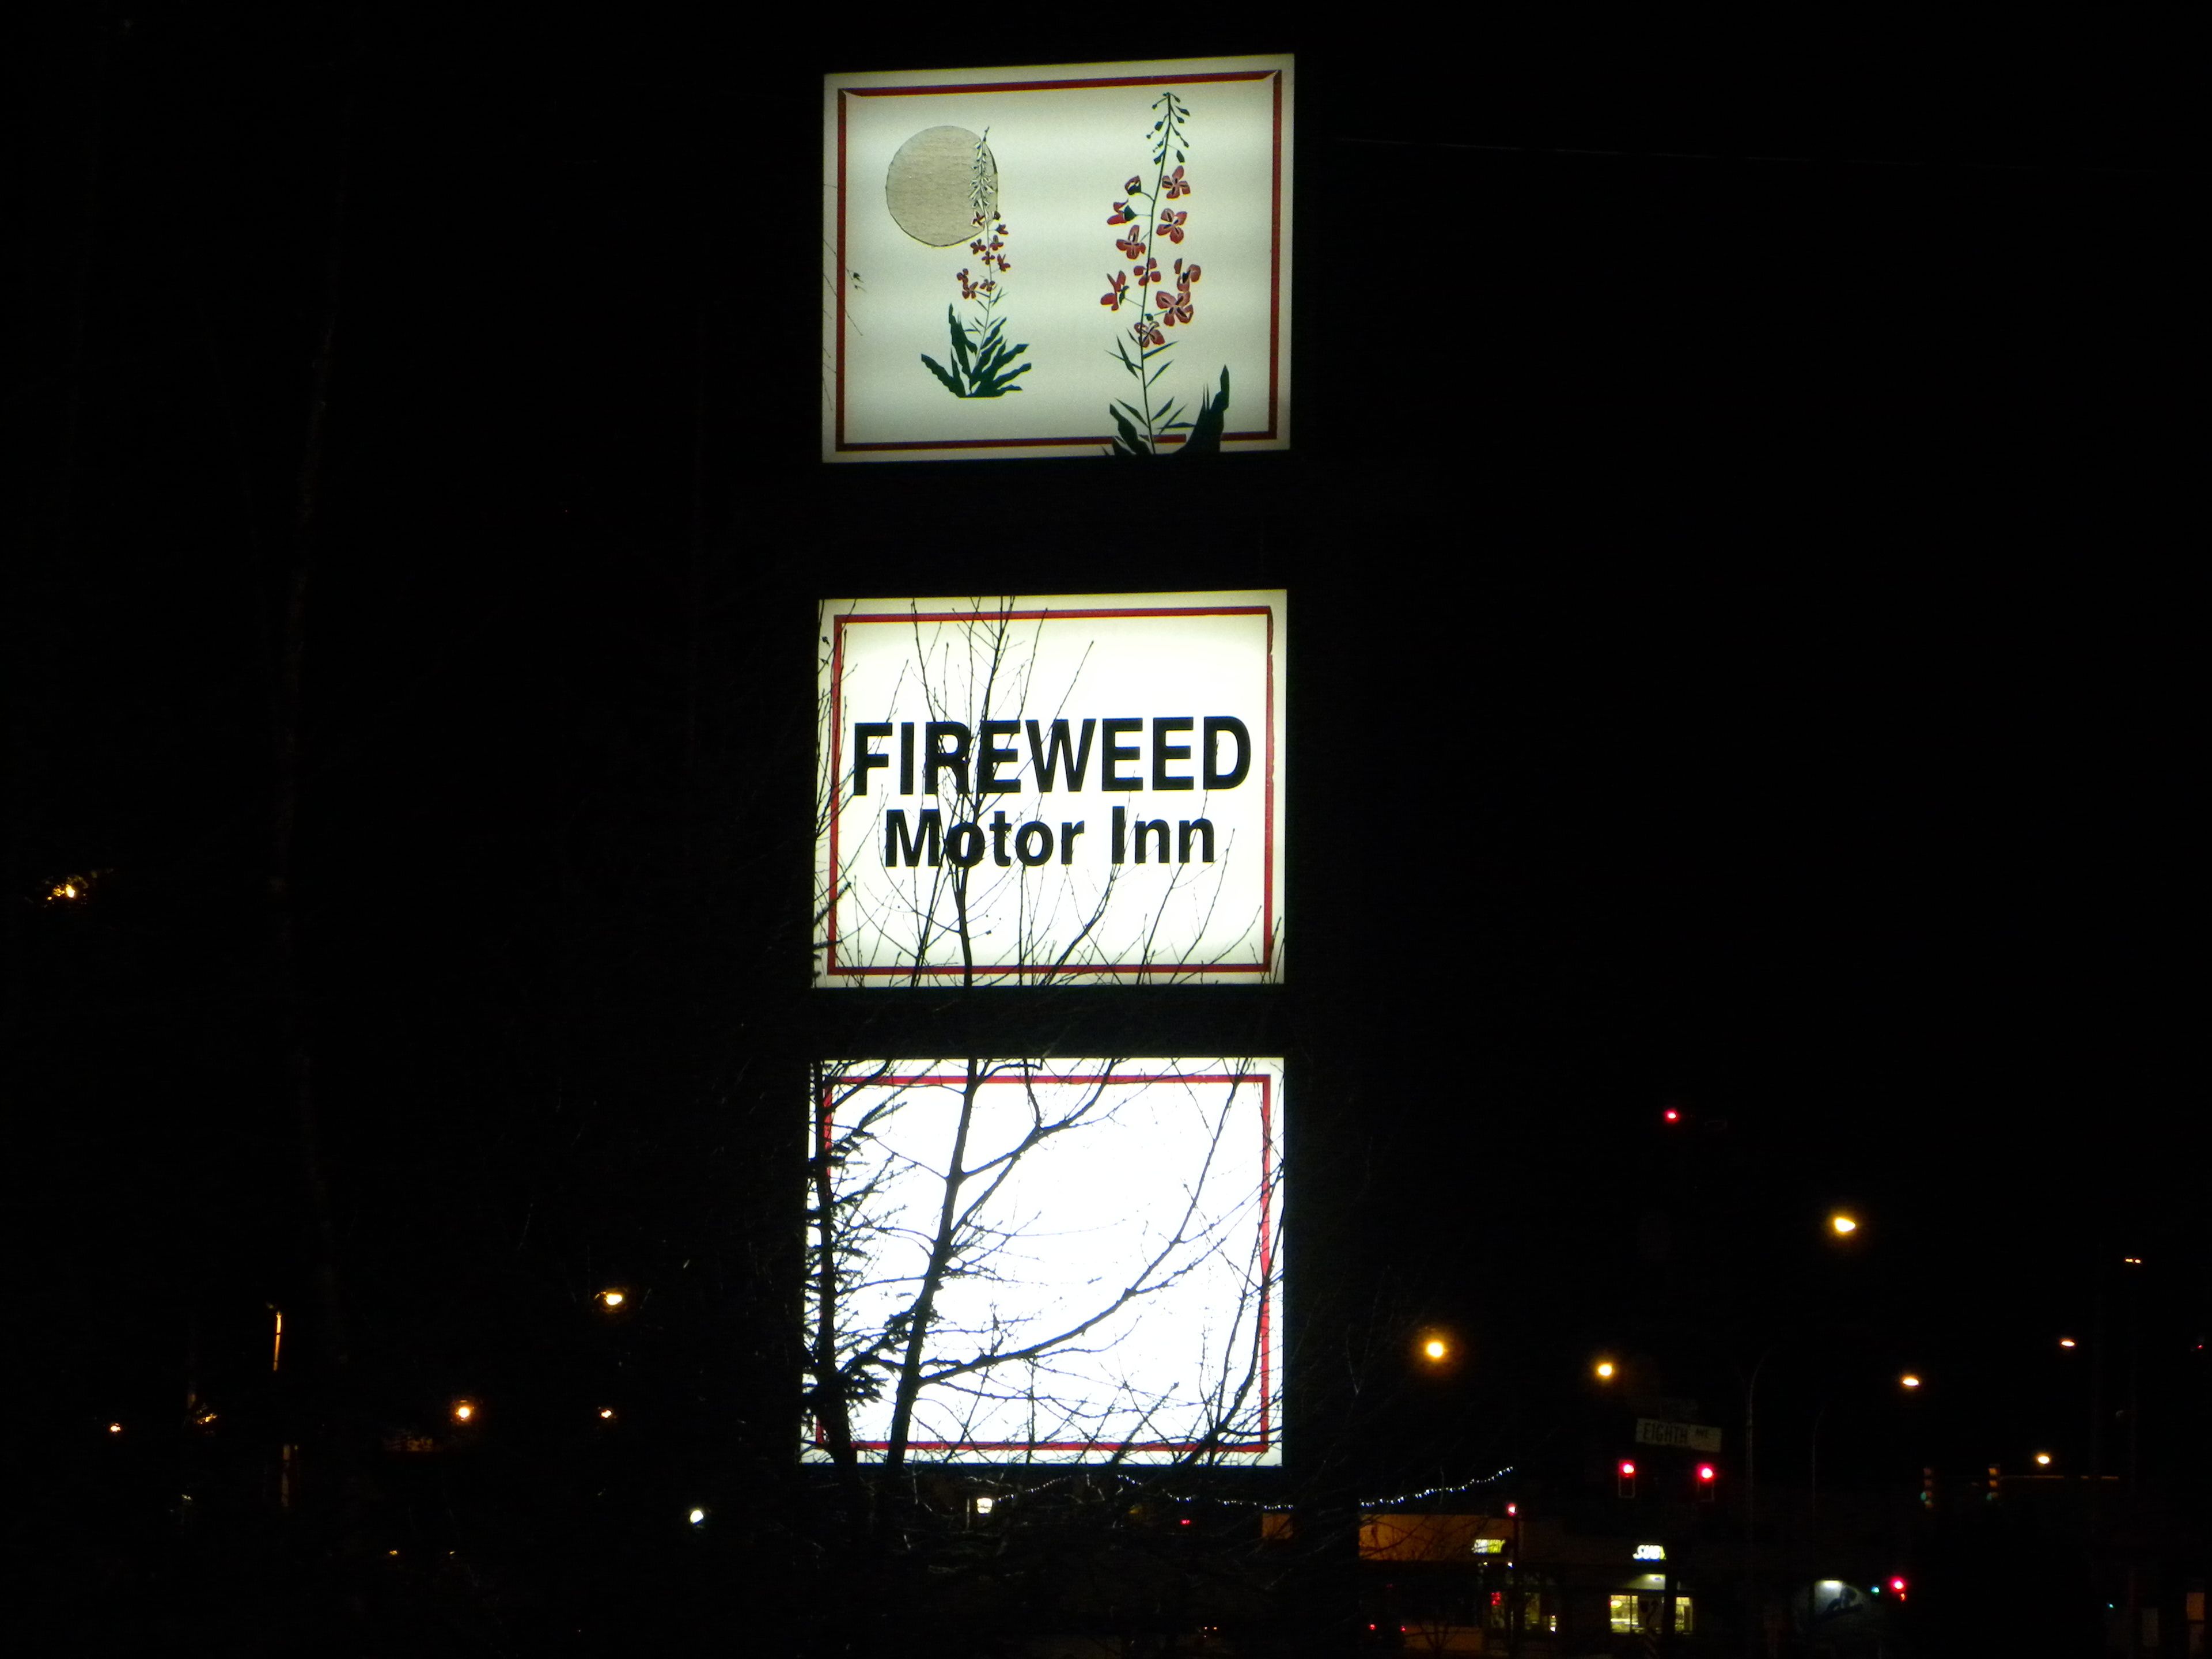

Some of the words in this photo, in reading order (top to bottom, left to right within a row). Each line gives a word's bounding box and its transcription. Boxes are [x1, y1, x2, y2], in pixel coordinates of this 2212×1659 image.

[853, 716, 1251, 796] FIREWEED
[885, 808, 1085, 868] Motor
[1111, 806, 1215, 865] Inn
